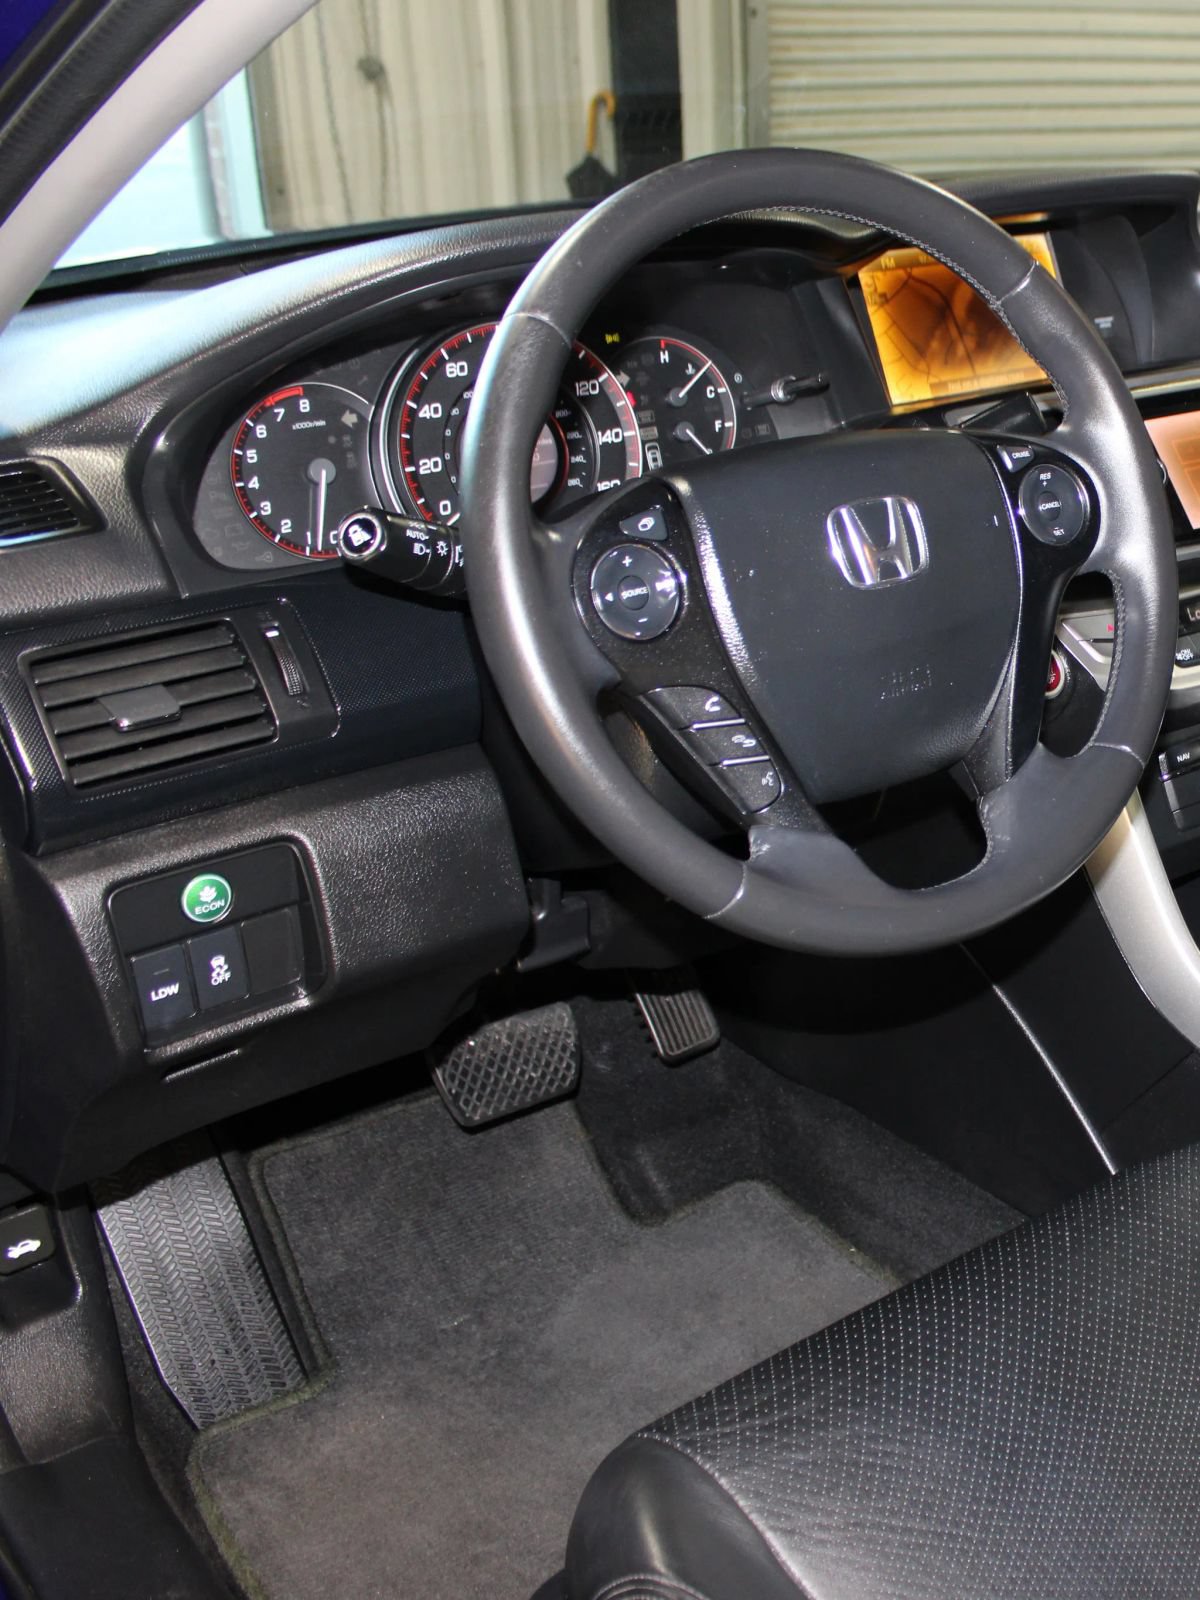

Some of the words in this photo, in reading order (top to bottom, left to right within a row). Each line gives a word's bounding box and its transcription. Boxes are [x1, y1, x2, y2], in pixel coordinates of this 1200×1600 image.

[659, 350, 669, 364] H
[445, 361, 468, 378] 60
[575, 380, 600, 397] 120
[706, 386, 715, 399] C
[299, 399, 310, 413] 8
[418, 403, 442, 420] 40
[273, 409, 285, 423] 7
[255, 425, 267, 439] 6
[714, 420, 722, 433] F
[597, 428, 623, 446] 140
[246, 449, 258, 464] 5
[419, 456, 442, 475] 20
[247, 475, 260, 490] 4
[259, 500, 272, 516] 3
[439, 500, 452, 516] 0
[280, 519, 293, 534] 2
[306, 530, 312, 545] 1
[405, 528, 426, 541] AUTO
[621, 586, 649, 600] SOURCE
[1176, 752, 1191, 763] NAV
[194, 898, 226, 916] ECON
[210, 971, 232, 987] OFF
[150, 982, 180, 1002] LDW
